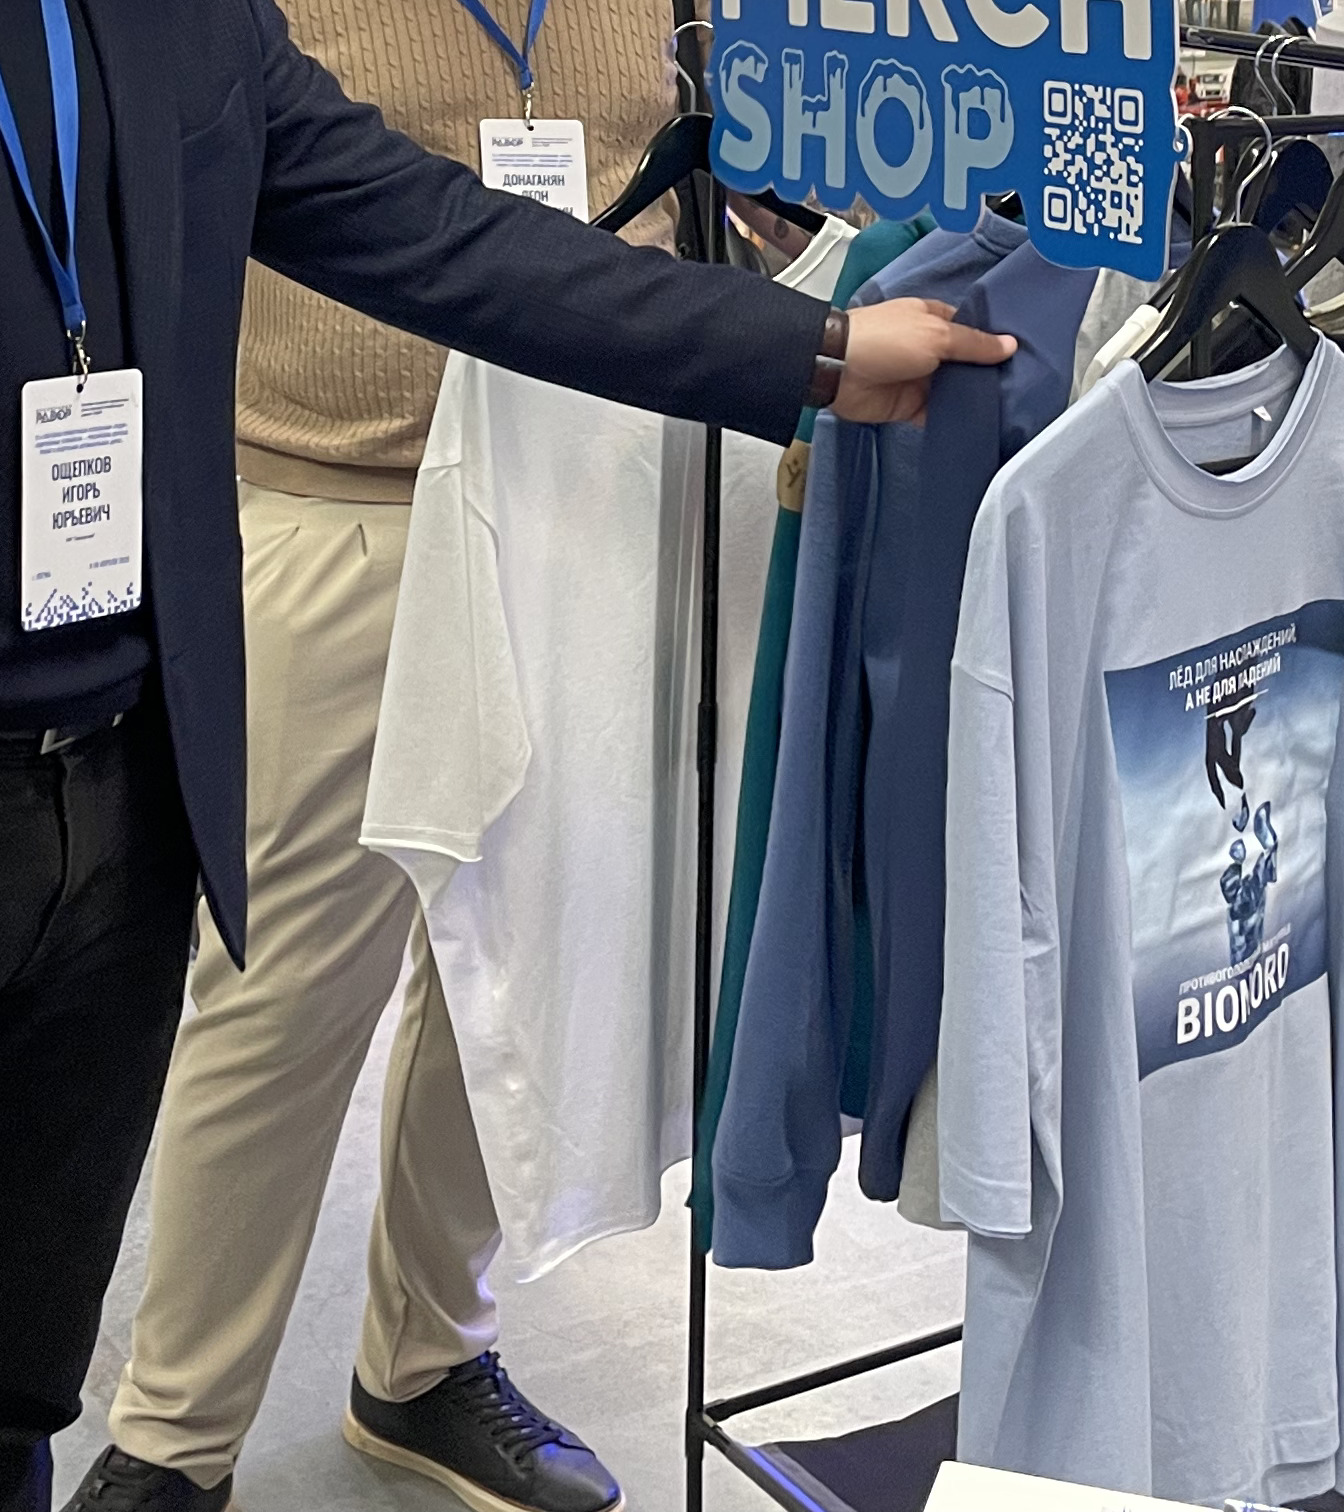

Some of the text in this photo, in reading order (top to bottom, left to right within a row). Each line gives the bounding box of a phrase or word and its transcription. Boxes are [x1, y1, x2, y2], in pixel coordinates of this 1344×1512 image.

[717, 39, 1016, 211] SHOP
[502, 173, 565, 187] ДОНАГАНЯН
[51, 455, 112, 481] ОЩЕПКОВ
[62, 481, 101, 504] ИГОРЬ
[52, 503, 111, 530] ЮРЬЕВИЧ
[1168, 664, 1193, 691] ЛЁД
[1195, 655, 1217, 685] ДЛЯ
[1185, 692, 1194, 712] А
[1196, 685, 1211, 707] НЕ
[1212, 675, 1237, 705] ДЛЯ
[1177, 942, 1290, 1045] BIONORD
